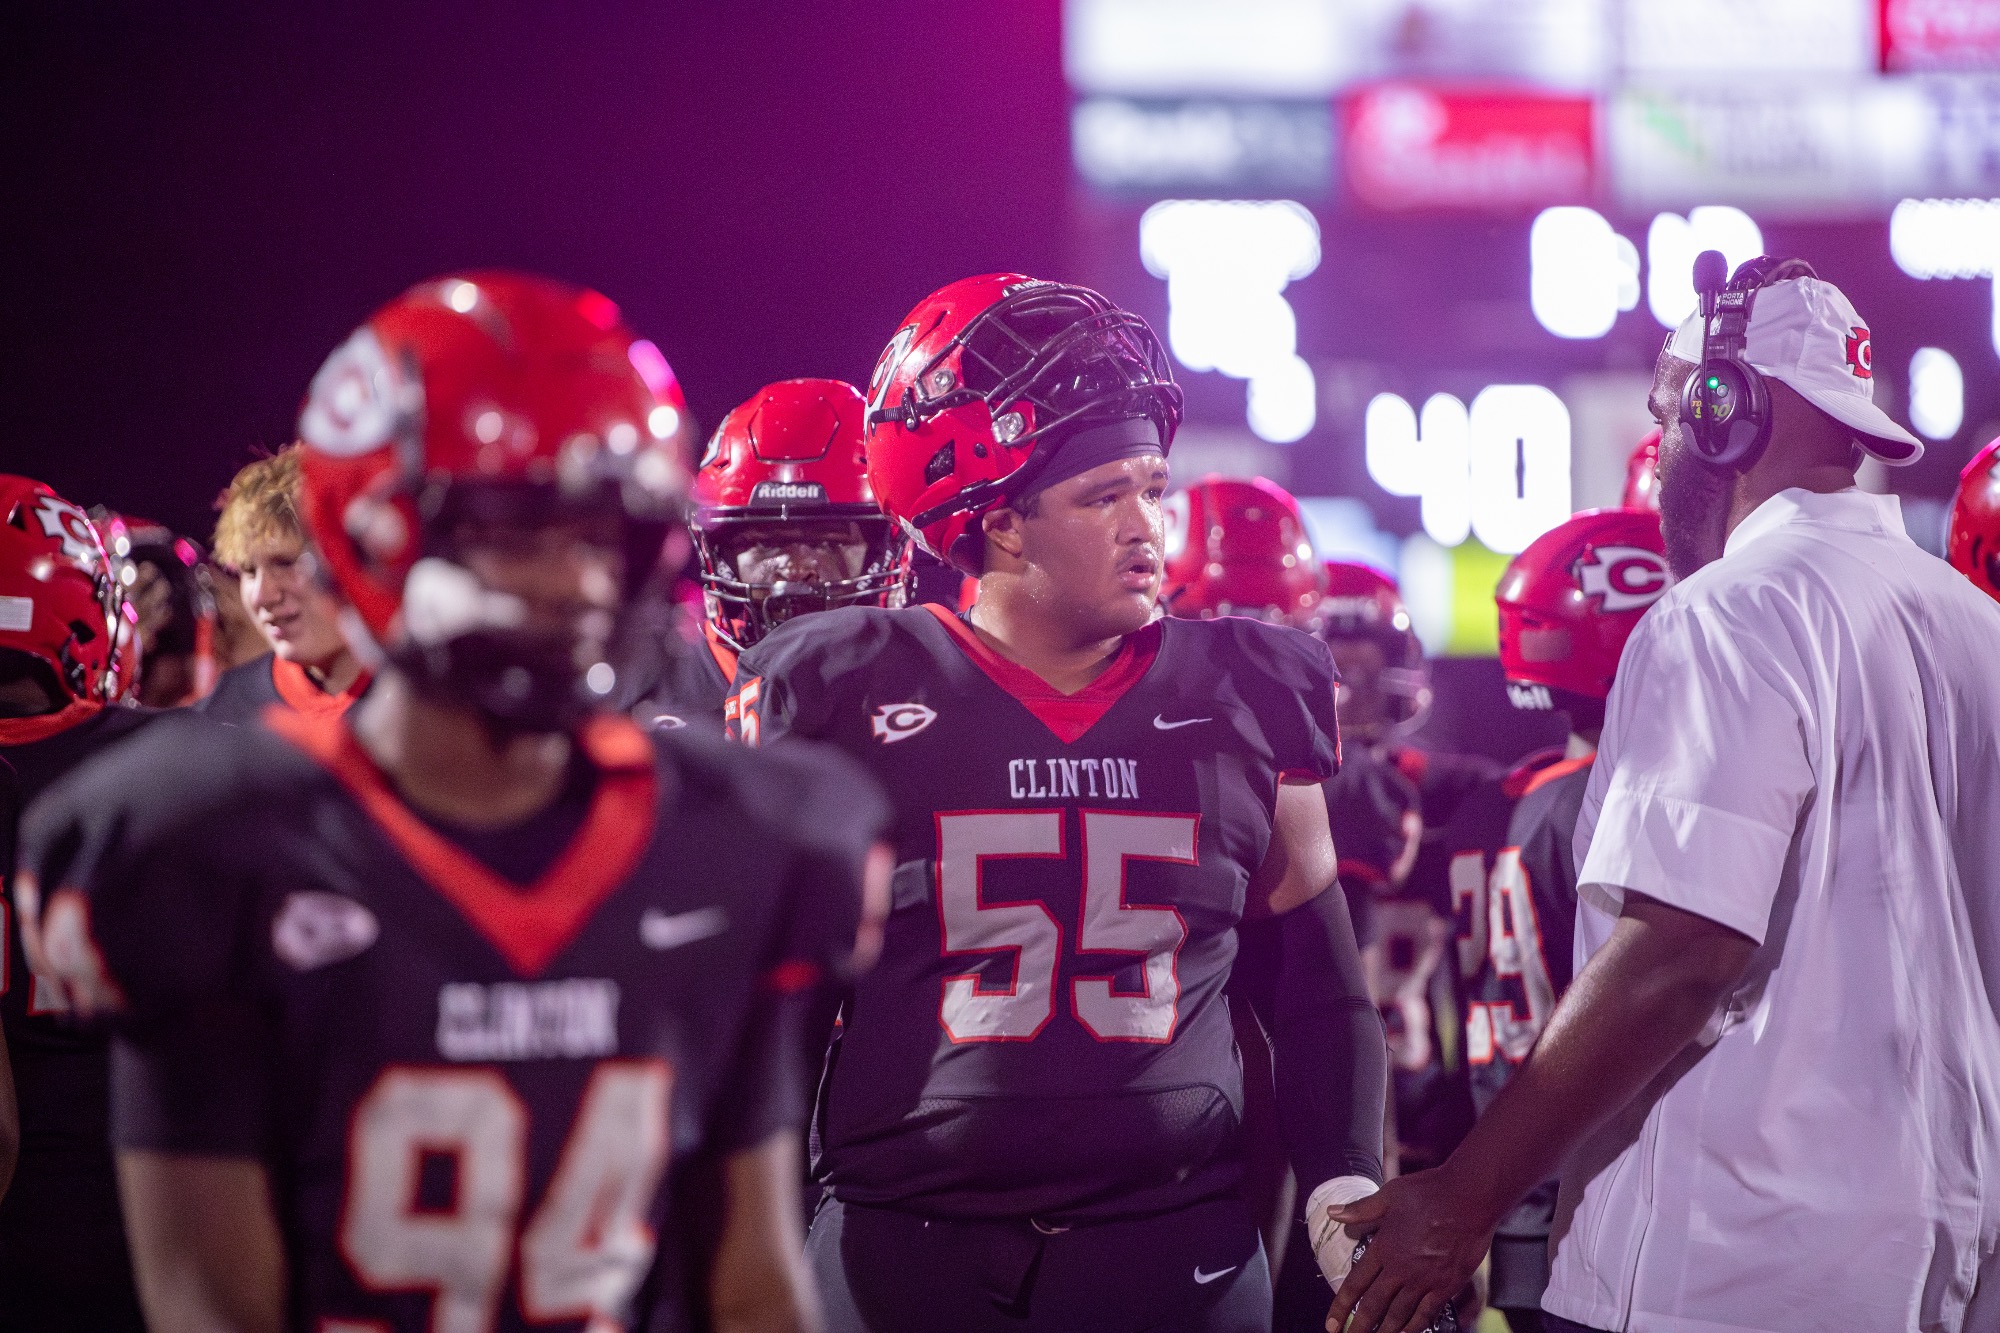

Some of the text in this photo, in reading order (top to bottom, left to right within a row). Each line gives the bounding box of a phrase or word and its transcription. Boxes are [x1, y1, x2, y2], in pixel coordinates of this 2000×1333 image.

[758, 484, 819, 498] Riddell
[1366, 384, 1572, 554] 40
[1008, 758, 1139, 799] CLINTON
[933, 807, 1202, 1044] 55
[337, 1056, 672, 1333] 94
